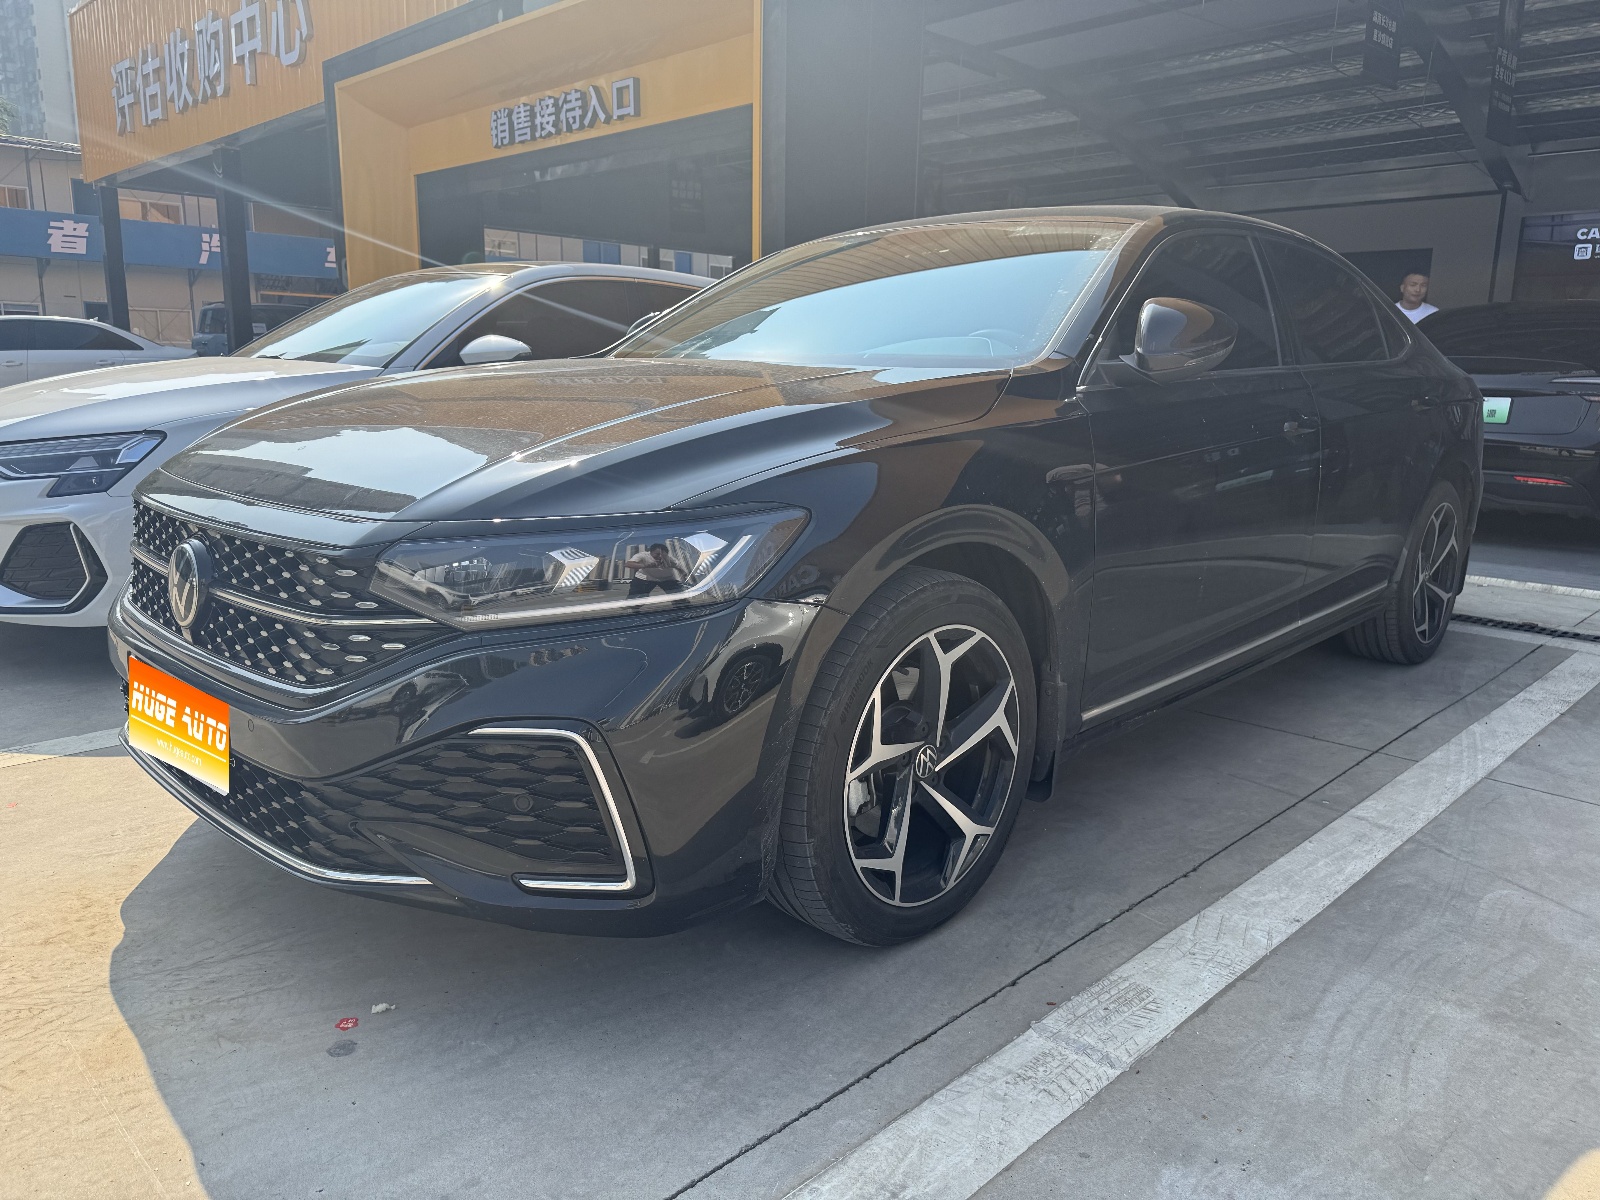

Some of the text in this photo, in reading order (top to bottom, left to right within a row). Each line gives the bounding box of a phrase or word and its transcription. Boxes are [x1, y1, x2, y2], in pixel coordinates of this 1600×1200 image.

[111, 0, 312, 136] 评估收购中心
[490, 76, 639, 148] 销售接待入口
[47, 220, 89, 254] 者
